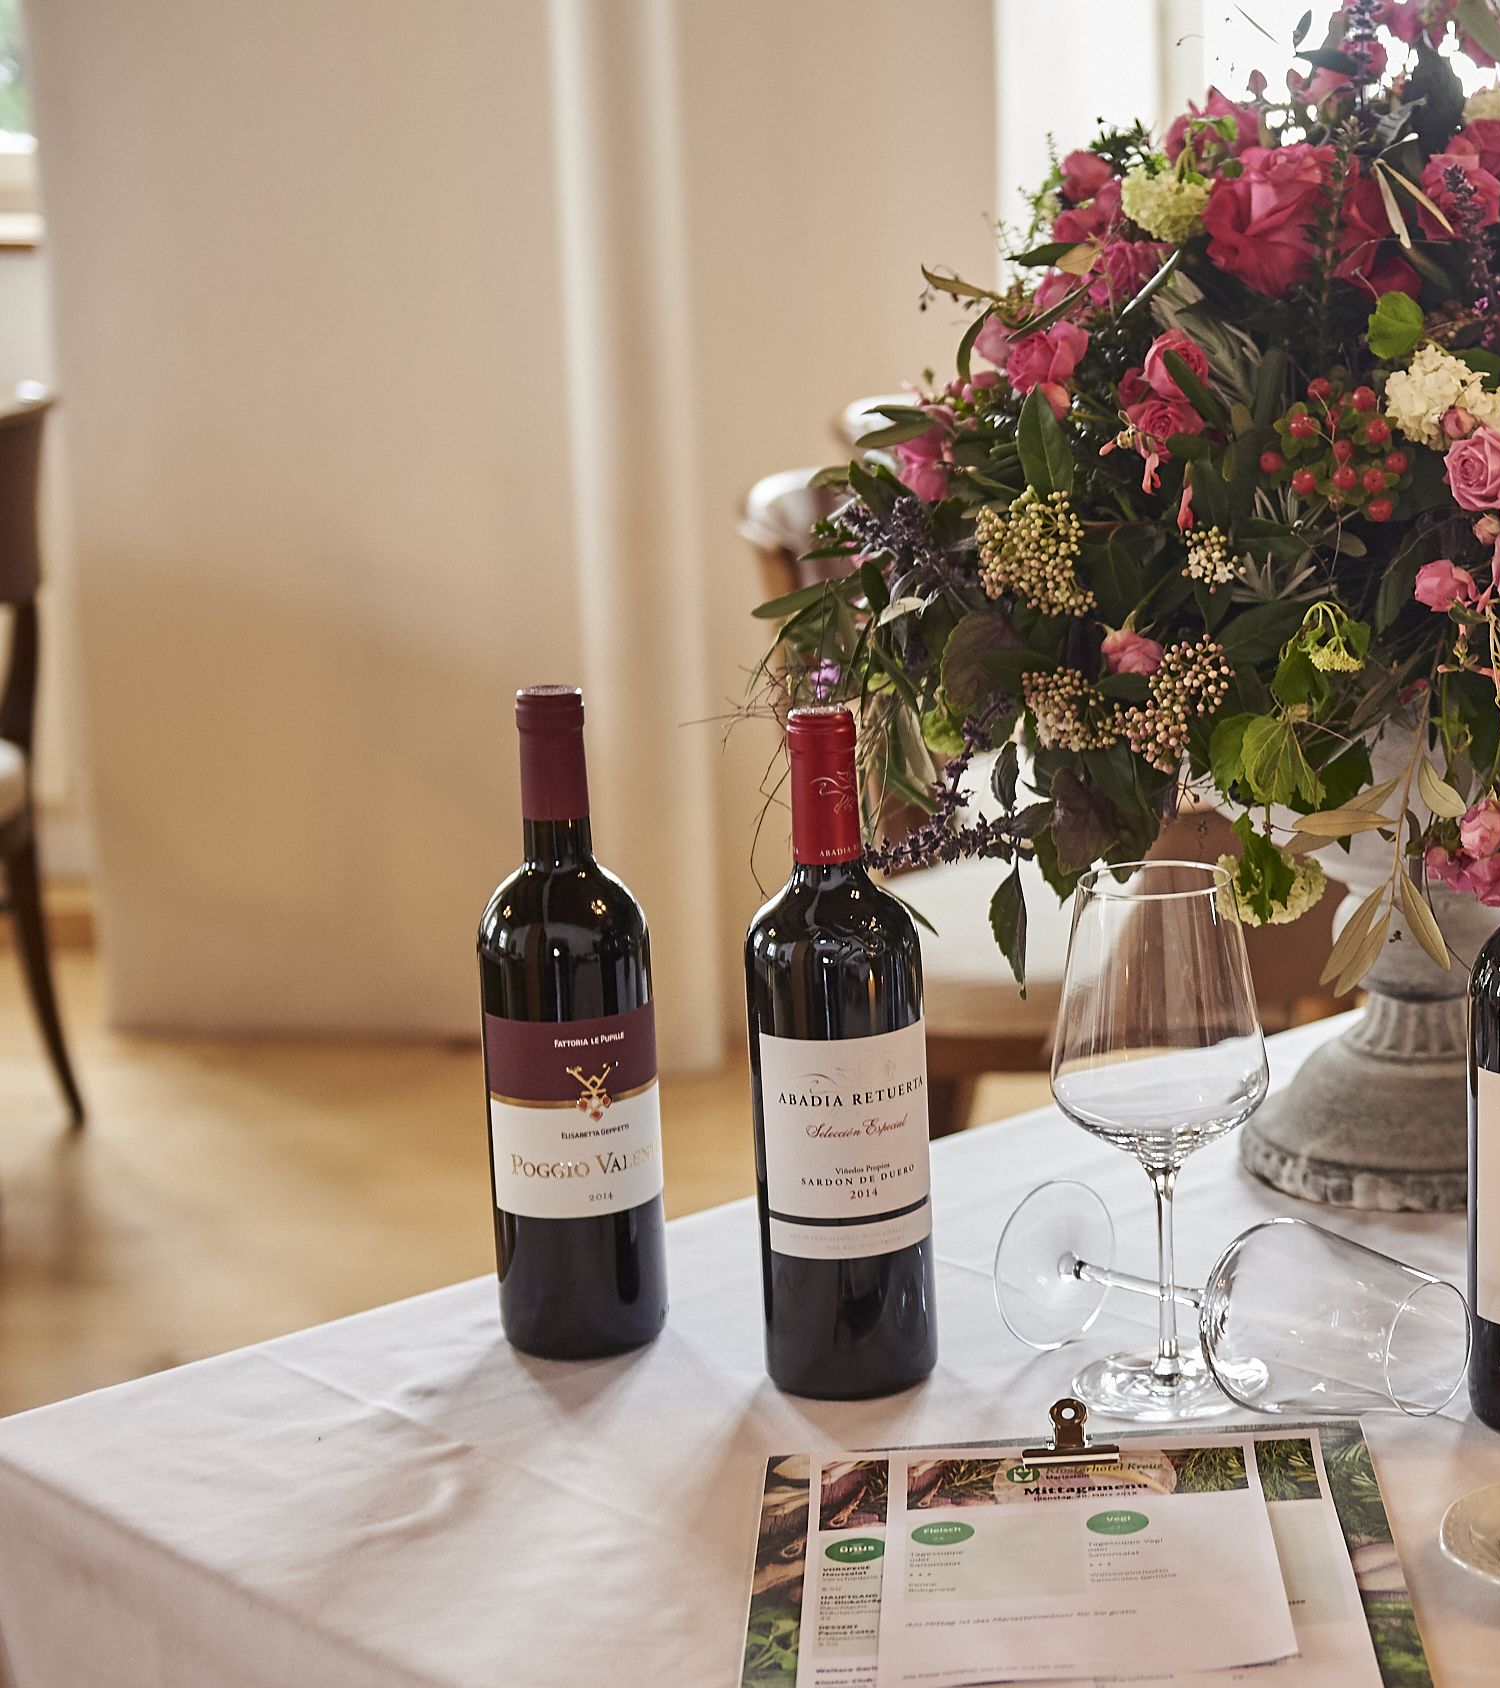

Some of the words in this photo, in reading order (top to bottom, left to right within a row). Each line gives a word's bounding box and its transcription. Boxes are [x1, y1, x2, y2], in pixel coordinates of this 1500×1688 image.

[819, 847, 852, 857] ABADIA
[553, 1038, 589, 1048] FATTORIA
[590, 1036, 599, 1045] LE
[600, 1031, 624, 1043] PUPILLE
[778, 1092, 843, 1107] ABADIA
[852, 1075, 923, 1105] RETUERTA
[806, 1122, 861, 1139] Selección
[862, 1112, 908, 1137] Especial
[561, 1130, 600, 1140] ELISABETTA
[511, 1153, 590, 1179] POGGIO
[801, 1177, 853, 1187] SARDON
[859, 1174, 875, 1184] DE
[881, 1163, 915, 1181] DUERO
[589, 1191, 613, 1202] 2014
[850, 1187, 878, 1200] 2014
